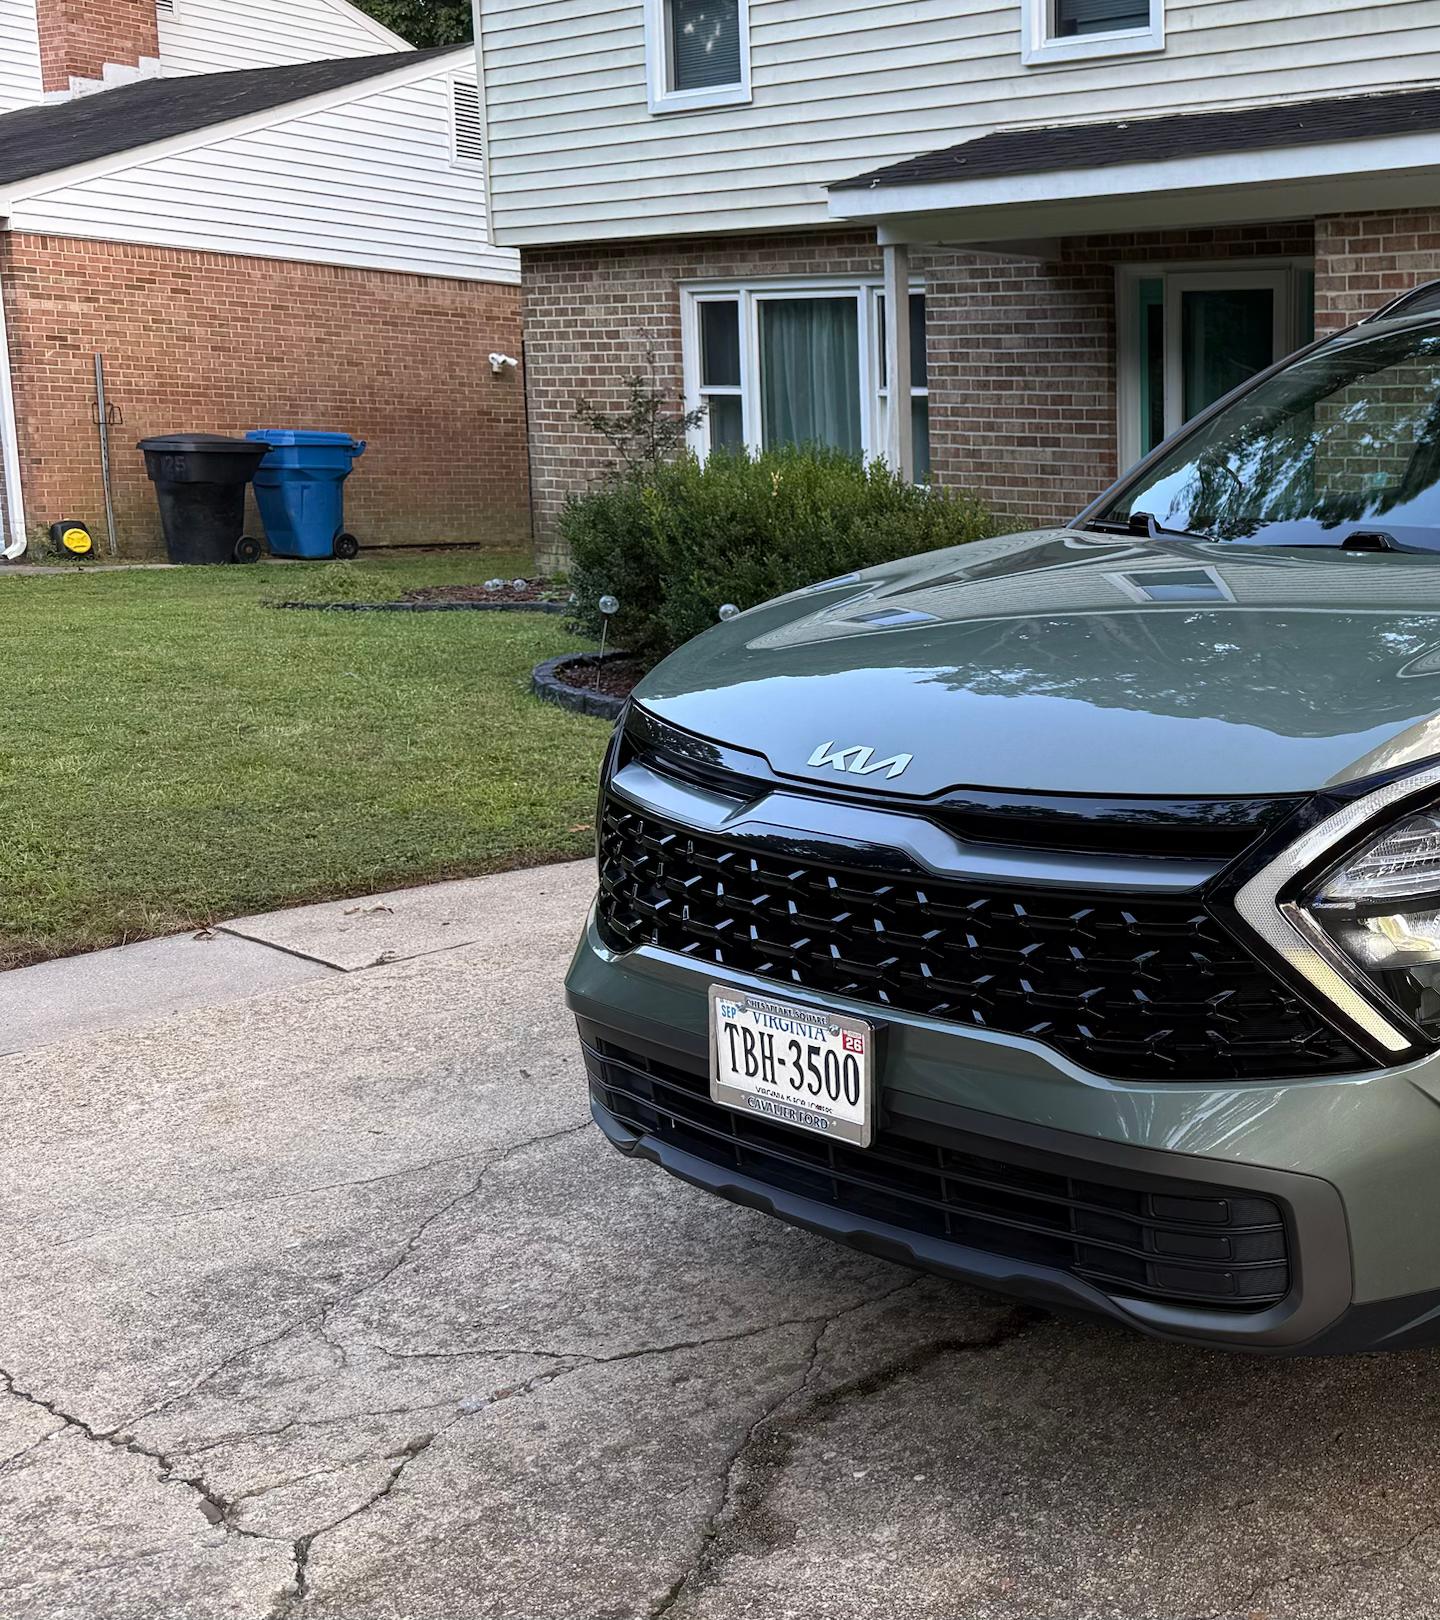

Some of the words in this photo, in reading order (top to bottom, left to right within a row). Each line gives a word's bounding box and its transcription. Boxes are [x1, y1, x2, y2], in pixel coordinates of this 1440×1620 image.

[807, 740, 914, 780] KIA
[721, 1004, 737, 1019] SEP
[753, 1012, 827, 1042] VIRGINIA
[845, 1036, 862, 1052] 26
[724, 1022, 860, 1106] TBH-3500
[747, 1096, 797, 1121] CAVALIER
[798, 1110, 829, 1130] FORD
